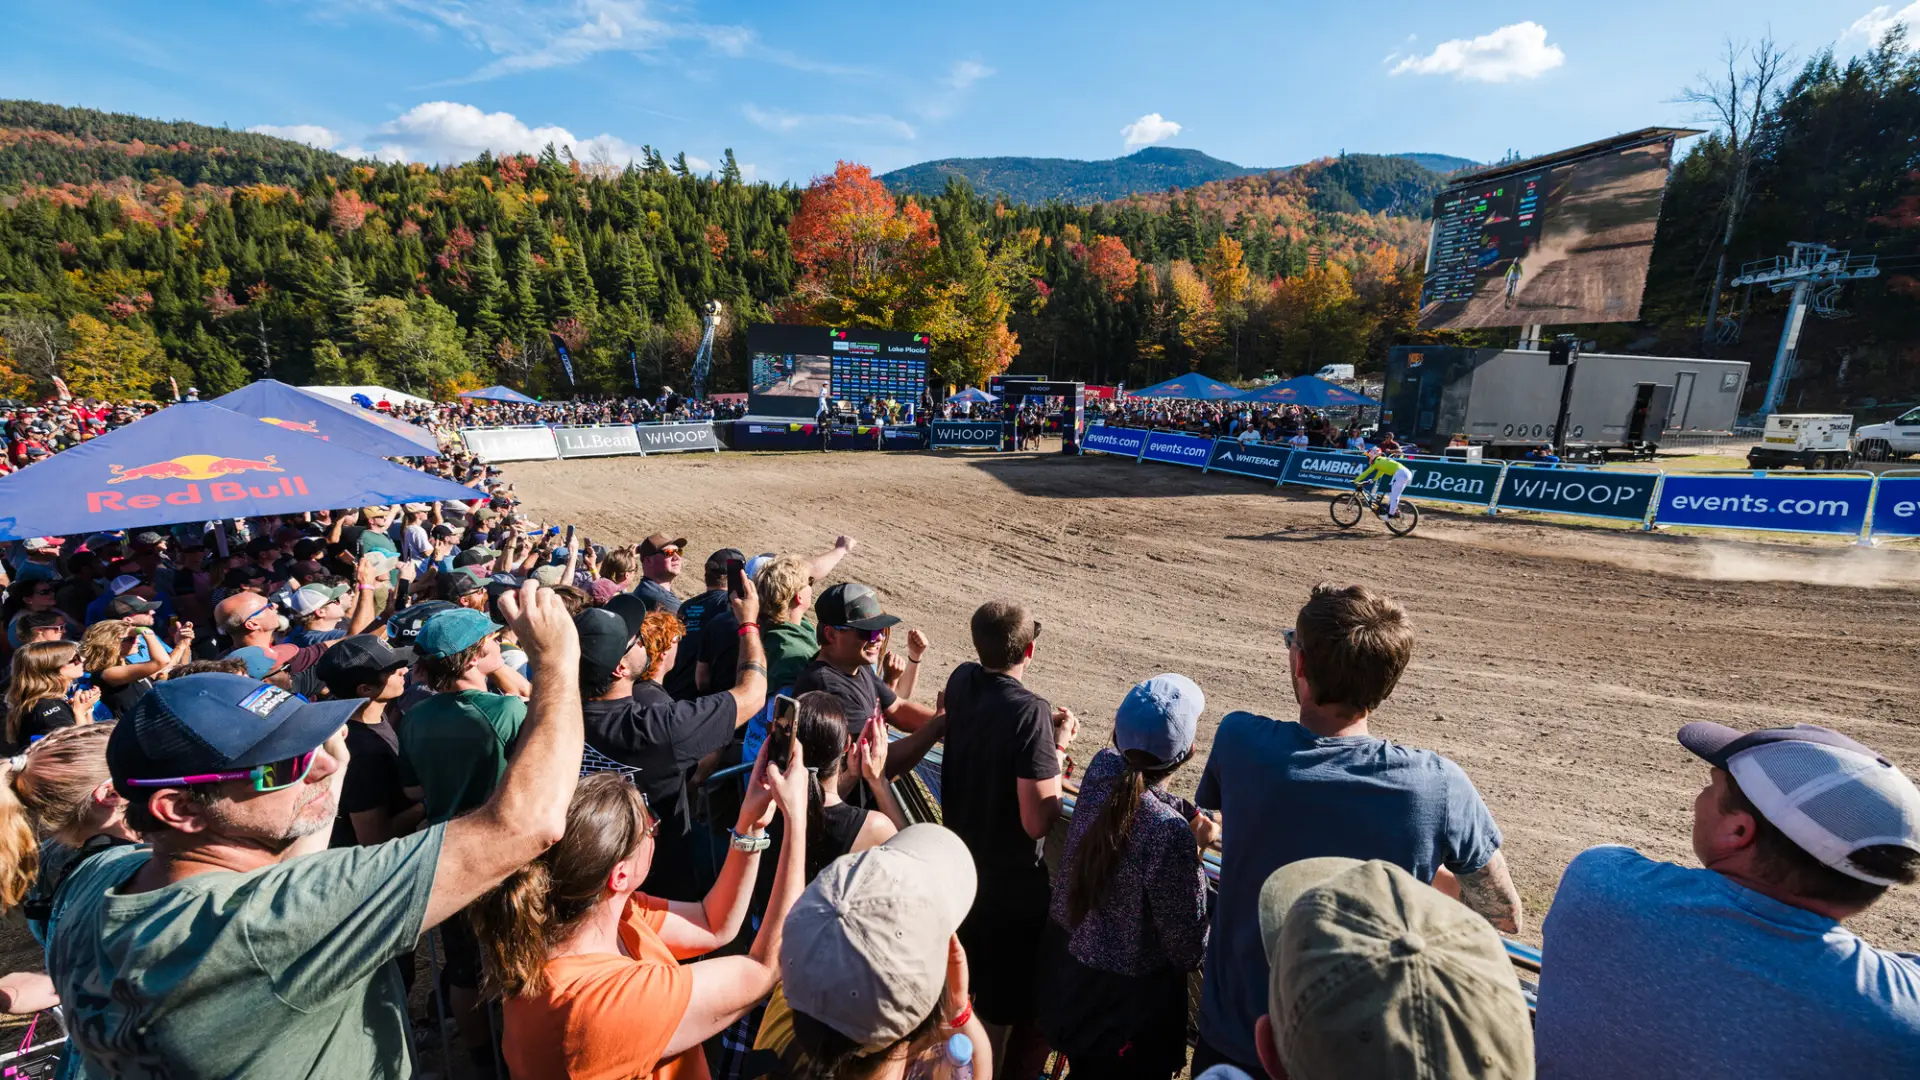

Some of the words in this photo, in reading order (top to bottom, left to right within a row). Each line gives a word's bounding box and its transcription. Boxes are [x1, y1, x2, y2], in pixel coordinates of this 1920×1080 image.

[905, 346, 926, 354] Placid
[564, 434, 632, 450] L.L.Bean
[645, 430, 707, 444] WHOOP
[937, 428, 995, 440] WHOOP
[1088, 432, 1140, 448] events.com
[1150, 441, 1206, 458] events.com
[1236, 453, 1280, 467] WHITEFACE
[86, 483, 202, 513] Red
[209, 476, 309, 503] Bull
[1513, 479, 1635, 505] WHOOP
[1671, 494, 1850, 517] events.com
[45, 705, 61, 715] UCI
